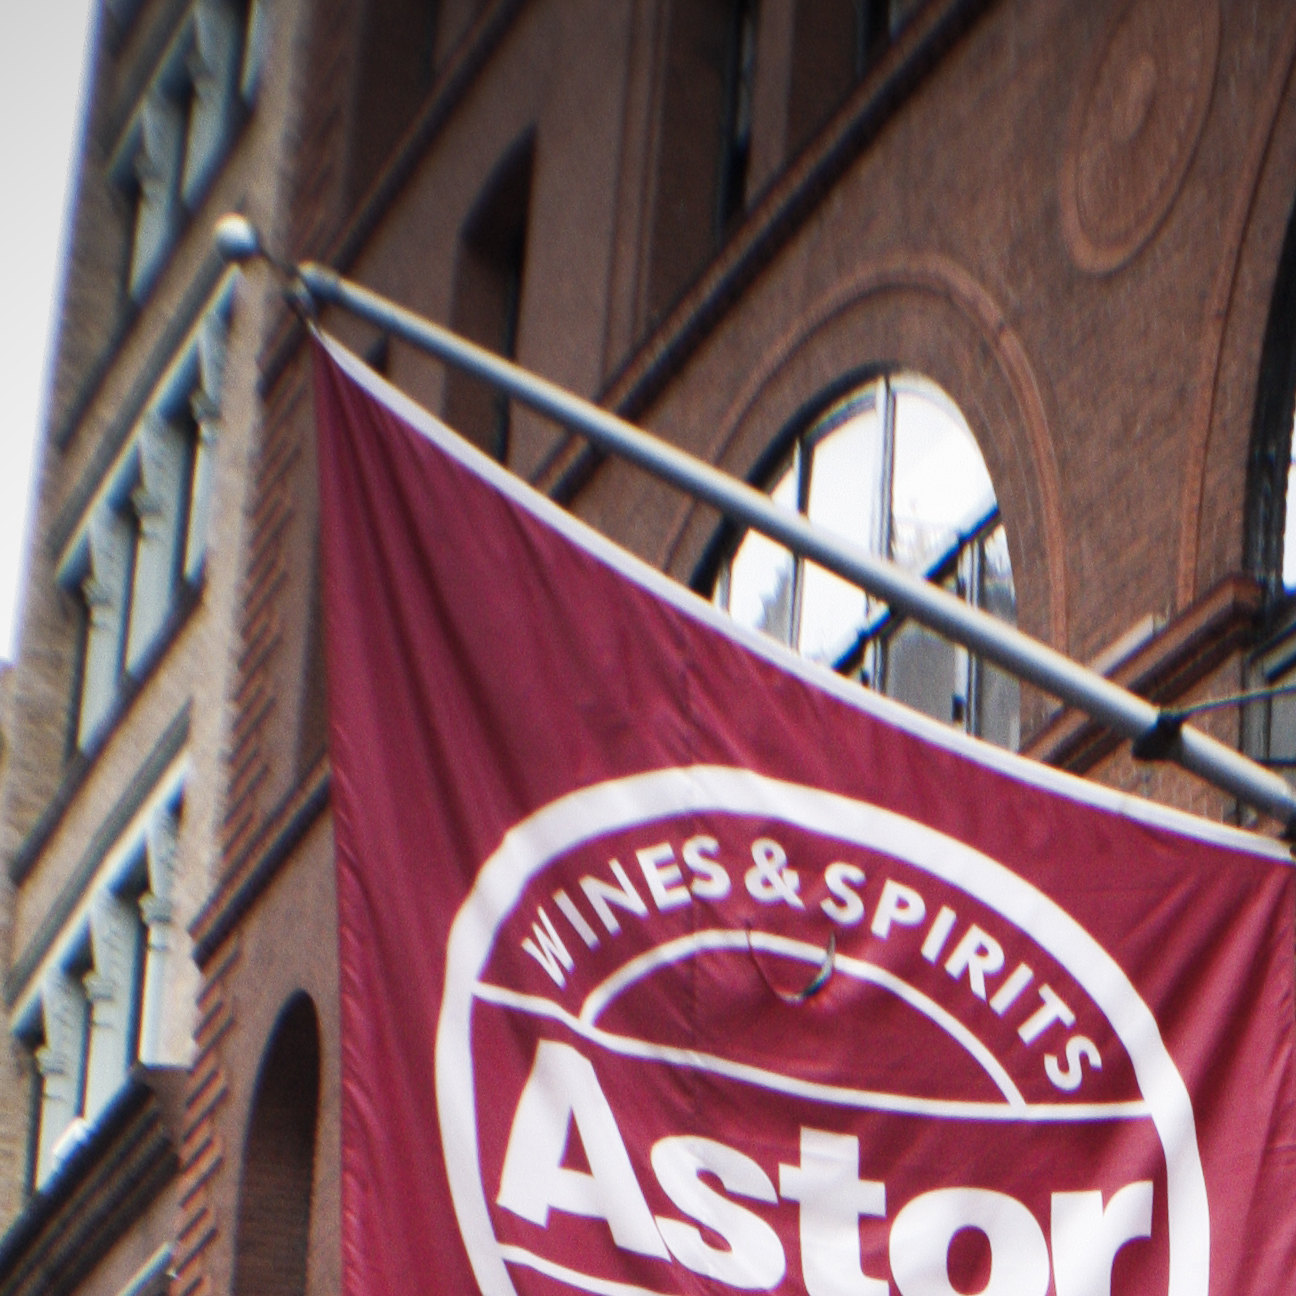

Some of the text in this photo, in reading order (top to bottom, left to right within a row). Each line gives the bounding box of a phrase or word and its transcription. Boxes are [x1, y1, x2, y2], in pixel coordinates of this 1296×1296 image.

[522, 834, 1103, 1092] WINES & SPIRITS
